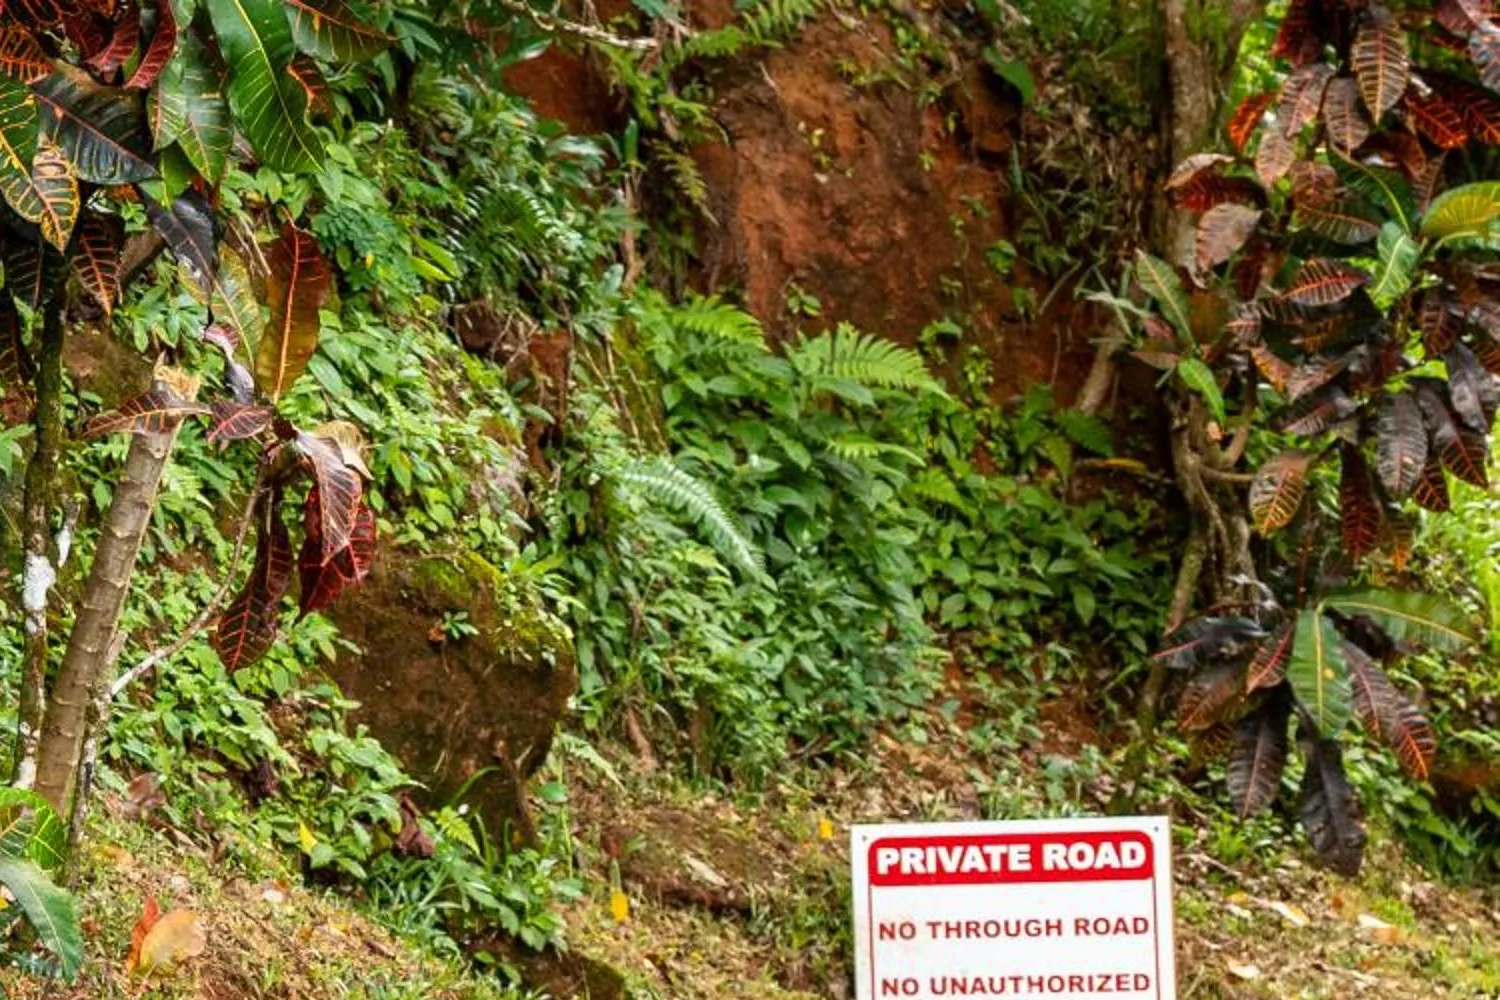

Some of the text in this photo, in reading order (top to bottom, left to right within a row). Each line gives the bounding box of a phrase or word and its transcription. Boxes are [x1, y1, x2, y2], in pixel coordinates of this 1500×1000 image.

[876, 840, 1147, 875] PRIVATE ROAD
[878, 916, 1150, 941] NO THROUGH ROAD
[881, 972, 1151, 997] NO UNAUTHORIZED
